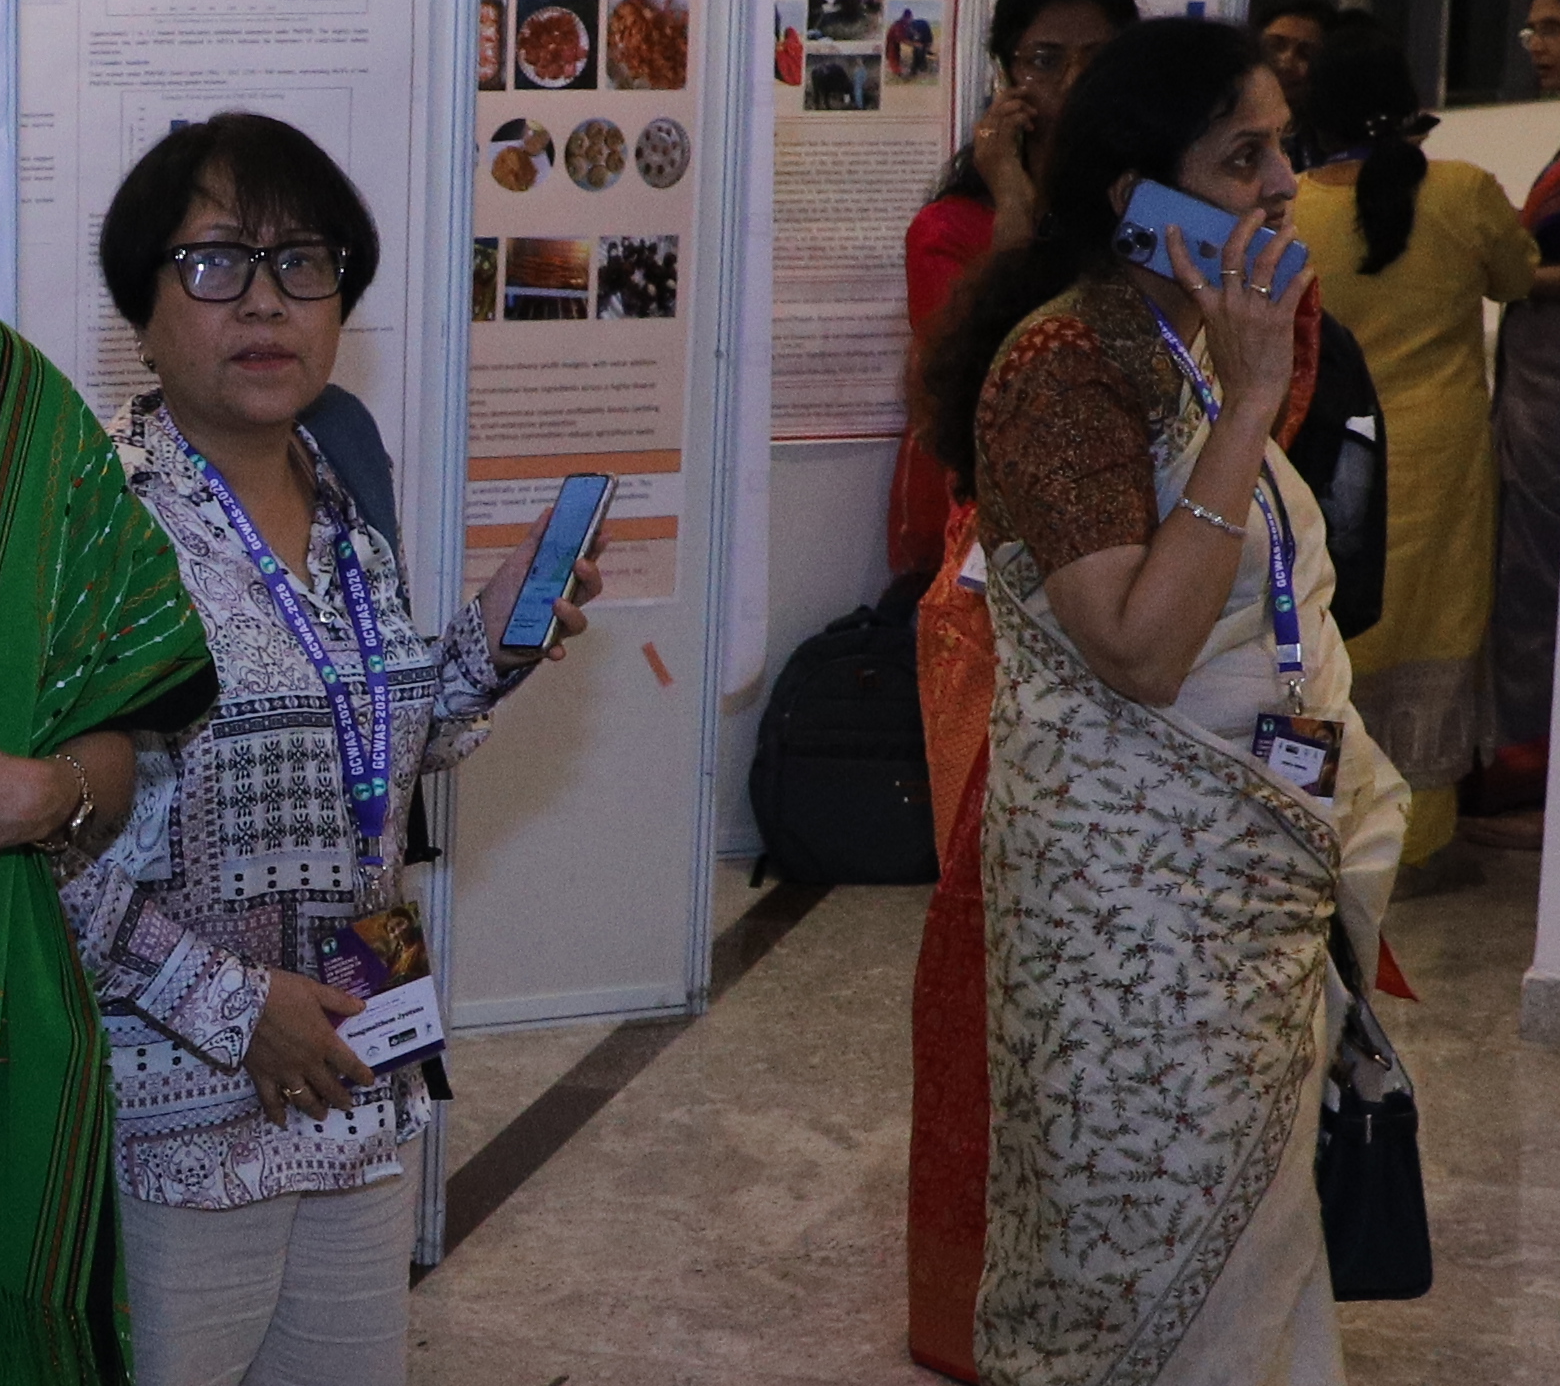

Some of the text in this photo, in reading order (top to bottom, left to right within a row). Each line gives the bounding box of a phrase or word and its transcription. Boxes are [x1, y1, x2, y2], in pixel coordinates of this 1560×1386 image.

[209, 479, 263, 550] GCWAS-2026
[275, 583, 325, 660] GCWAS-2026
[346, 568, 377, 647] GCWAS-2026
[337, 695, 364, 776] GCWAS-2026
[372, 686, 386, 770] GCWAS-2026
